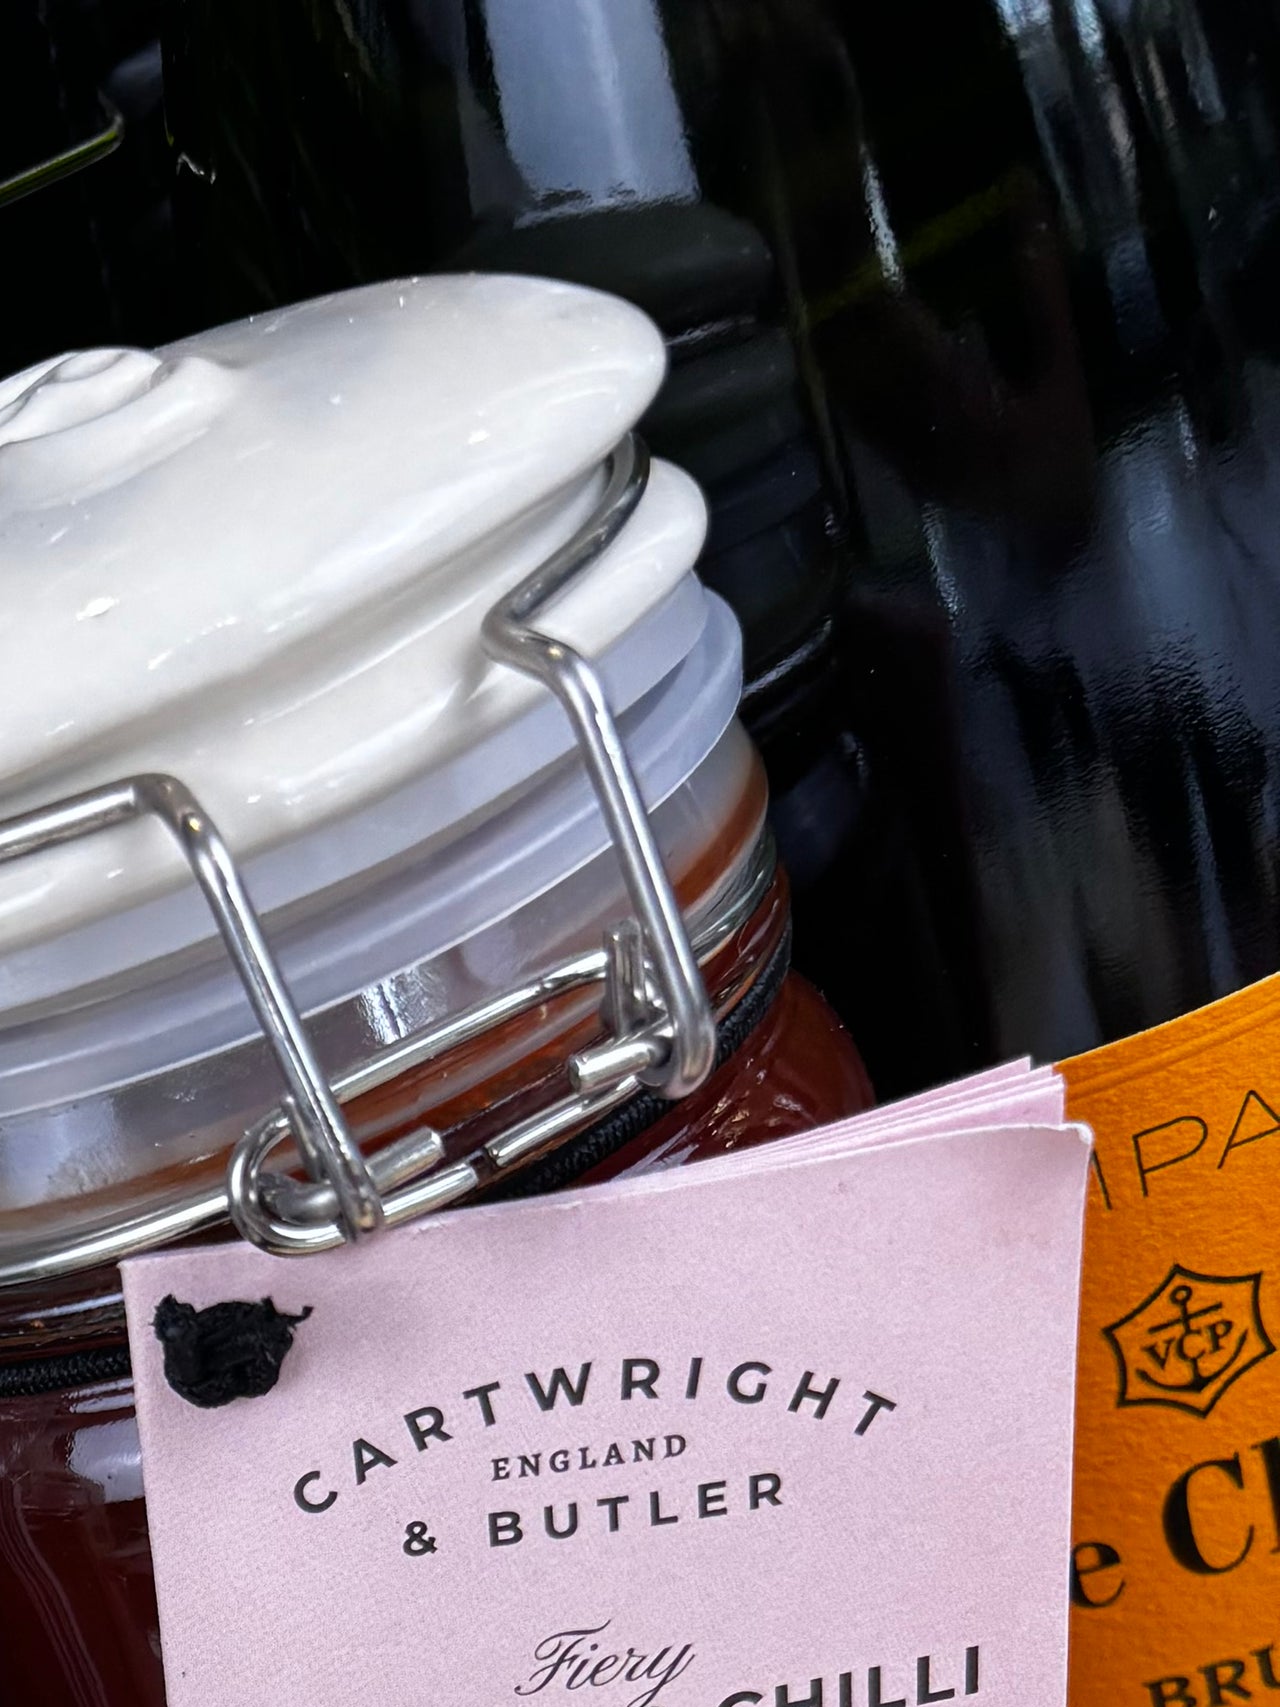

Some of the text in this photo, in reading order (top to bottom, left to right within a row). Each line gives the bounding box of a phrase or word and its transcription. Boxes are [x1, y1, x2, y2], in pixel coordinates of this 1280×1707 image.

[1092, 1089, 1280, 1210] PA
[294, 1358, 896, 1513] CARTWRIGHT
[492, 1435, 686, 1480] ENGLAND
[404, 1473, 782, 1556] & BUTLER
